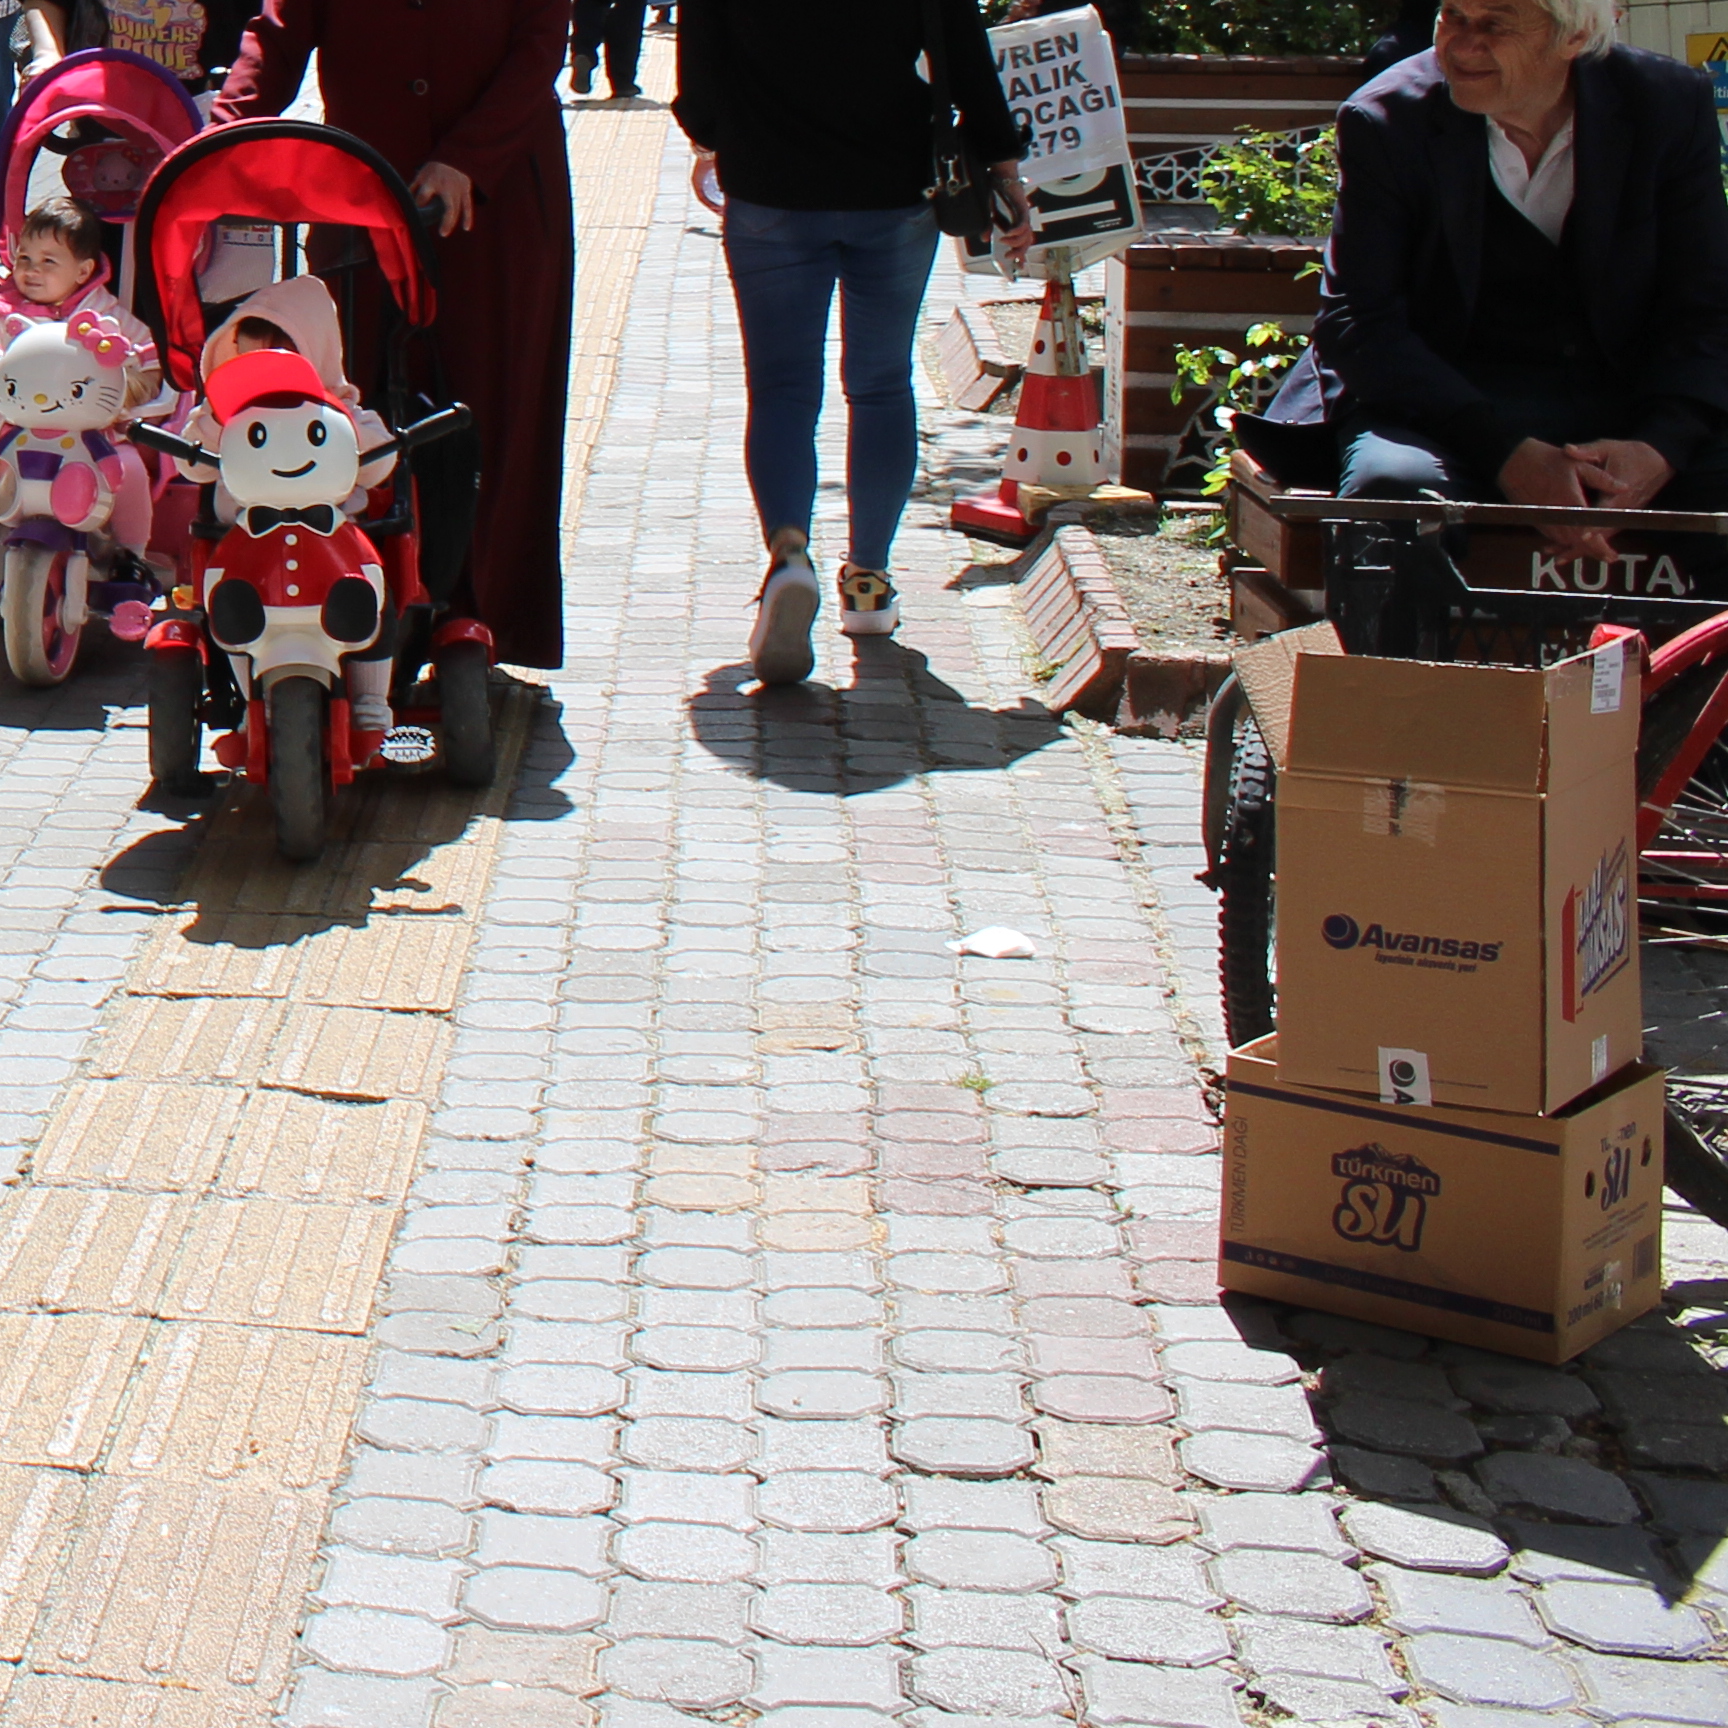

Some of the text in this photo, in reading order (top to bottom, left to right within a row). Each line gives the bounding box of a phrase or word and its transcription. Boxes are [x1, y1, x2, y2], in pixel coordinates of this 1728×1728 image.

[1007, 59, 1088, 101] ALIK
[1358, 923, 1500, 962] Avansas
[1230, 1161, 1247, 1234] TÜRKMEN
